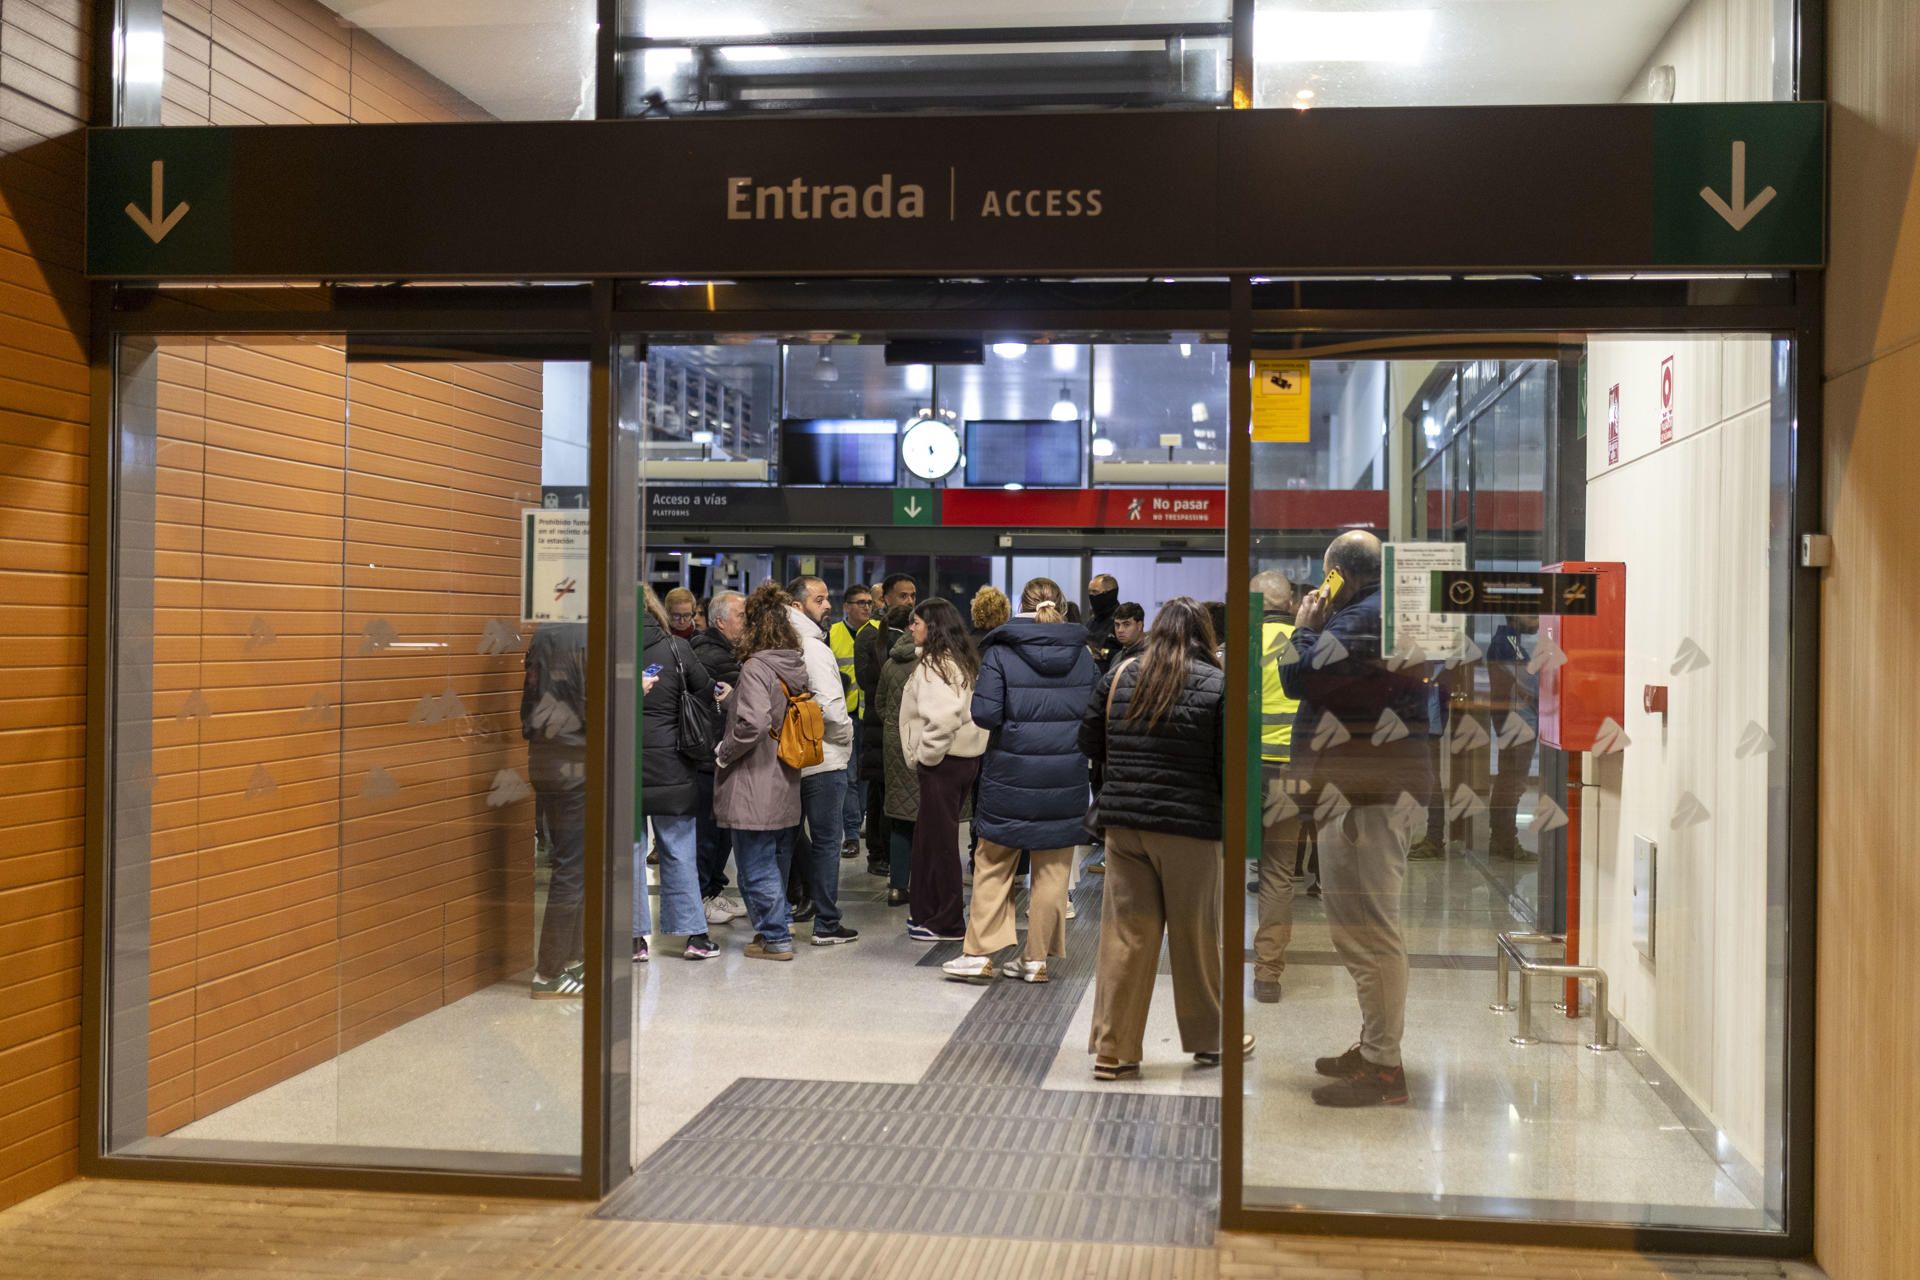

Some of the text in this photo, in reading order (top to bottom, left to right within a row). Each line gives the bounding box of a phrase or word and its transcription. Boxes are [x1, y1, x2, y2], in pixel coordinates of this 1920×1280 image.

[727, 174, 1103, 220] Entrada ACCESS
[653, 492, 727, 505] Acceso a vías
[1153, 498, 1209, 512] No pasar
